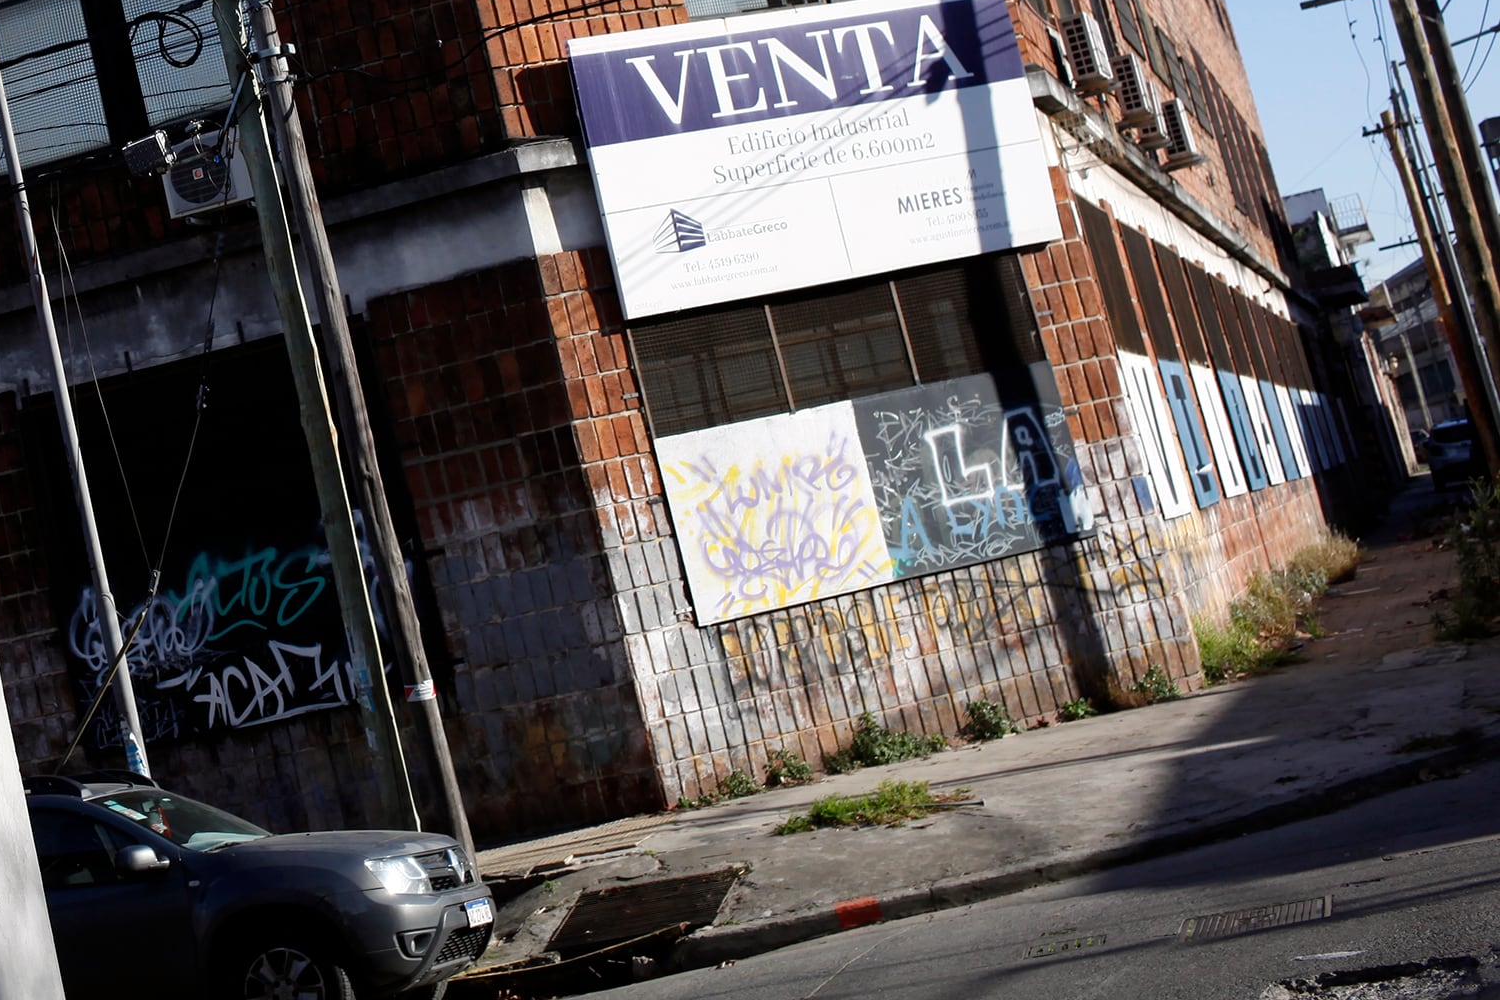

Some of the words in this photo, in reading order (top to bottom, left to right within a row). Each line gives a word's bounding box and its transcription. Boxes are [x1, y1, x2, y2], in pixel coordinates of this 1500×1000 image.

[626, 14, 974, 125] VENTA
[727, 127, 806, 155] Edificio
[811, 108, 910, 141] Industrial
[713, 151, 819, 184] Superficie
[823, 146, 847, 166] de
[852, 132, 935, 160] 6.600m2
[897, 187, 963, 214] MIERES
[706, 221, 788, 243] LabbateGreco
